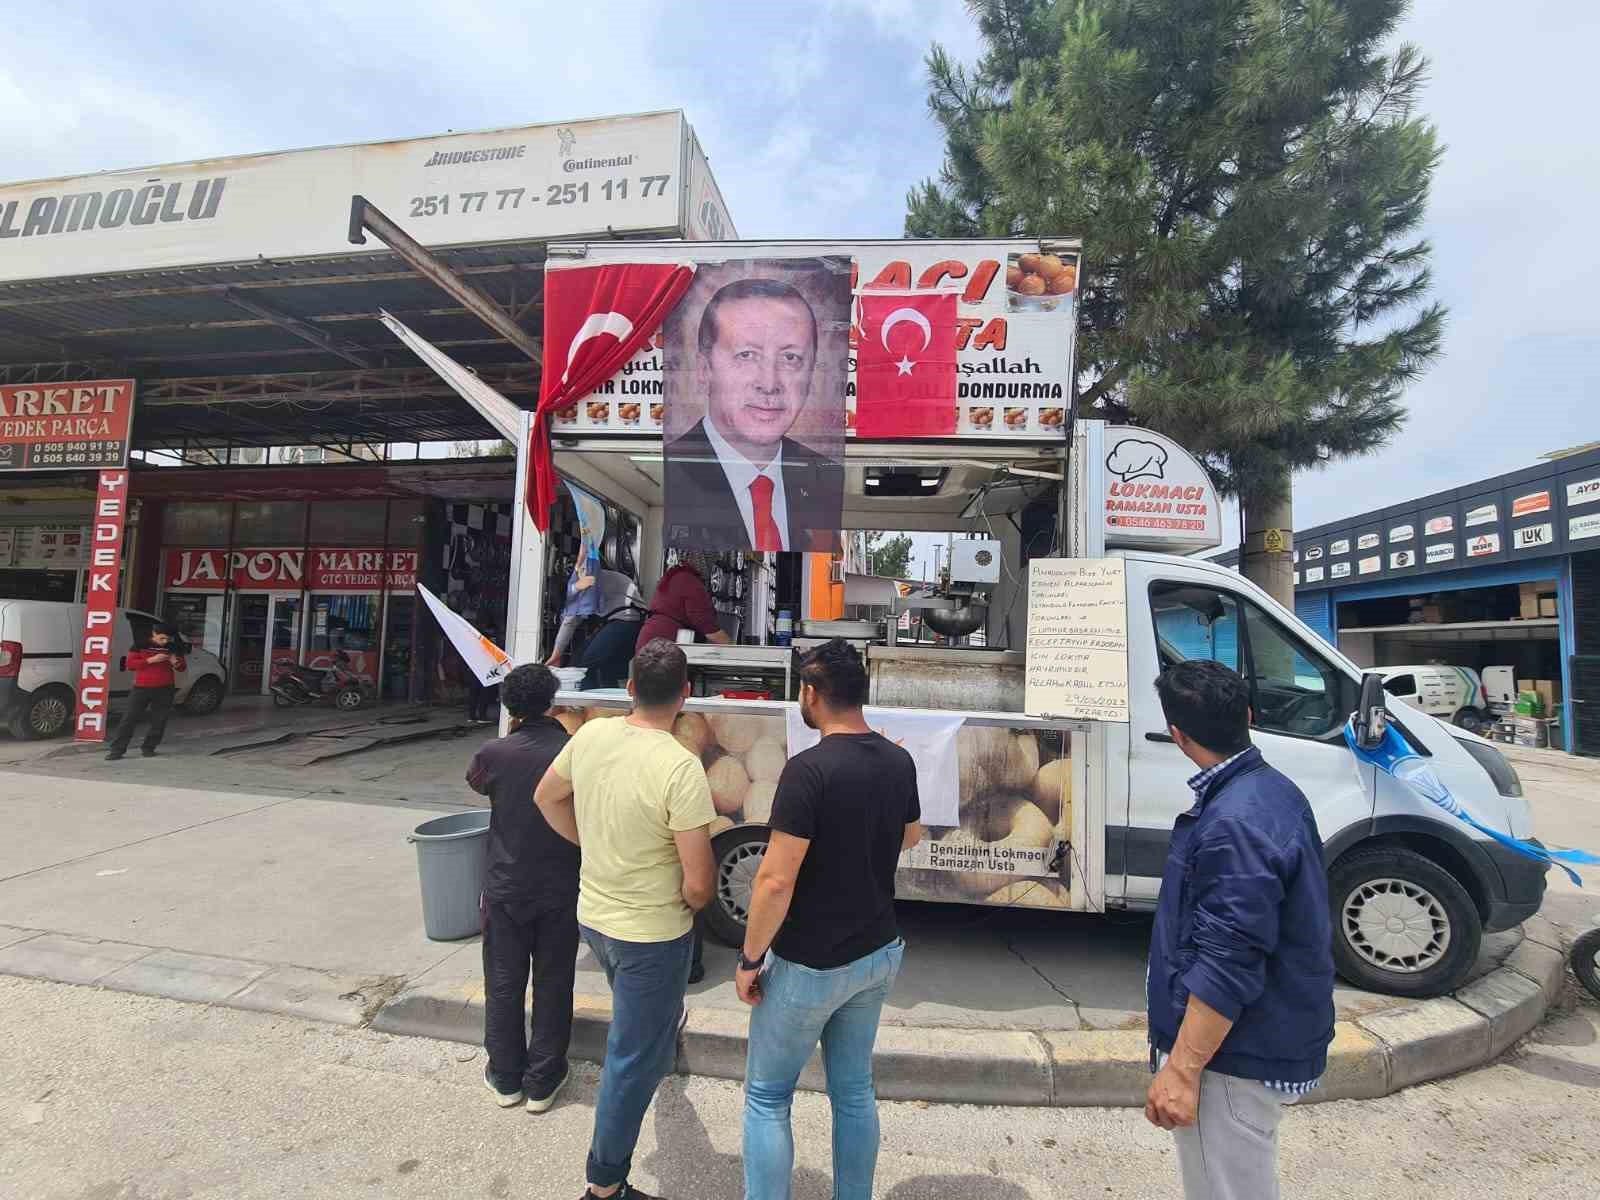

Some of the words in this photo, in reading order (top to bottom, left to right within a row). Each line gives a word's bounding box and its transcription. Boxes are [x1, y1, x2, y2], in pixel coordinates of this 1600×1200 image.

[424, 145, 527, 167] BRIDGESTONE
[563, 155, 634, 172] Continental
[409, 195, 450, 217] 251
[459, 192, 489, 213] 77
[496, 188, 526, 210] 77
[546, 182, 591, 206] 251
[601, 179, 629, 201] 11
[639, 175, 671, 198] 77
[0, 177, 227, 238] LAMOĞLU
[958, 382, 1063, 399] DONDURMA
[0, 419, 48, 438] EDEK
[51, 418, 111, 439] PARÇA
[1110, 480, 1204, 501] LOKMACI
[1106, 499, 1173, 514] RAMAZAN
[1176, 503, 1207, 516] USTA
[91, 474, 124, 593] YEDEK
[172, 551, 304, 585] JAPON
[78, 610, 112, 732] PARÇA
[930, 842, 991, 859] Denizlinin
[930, 856, 985, 871] Ramazan
[988, 859, 1016, 872] Usta
